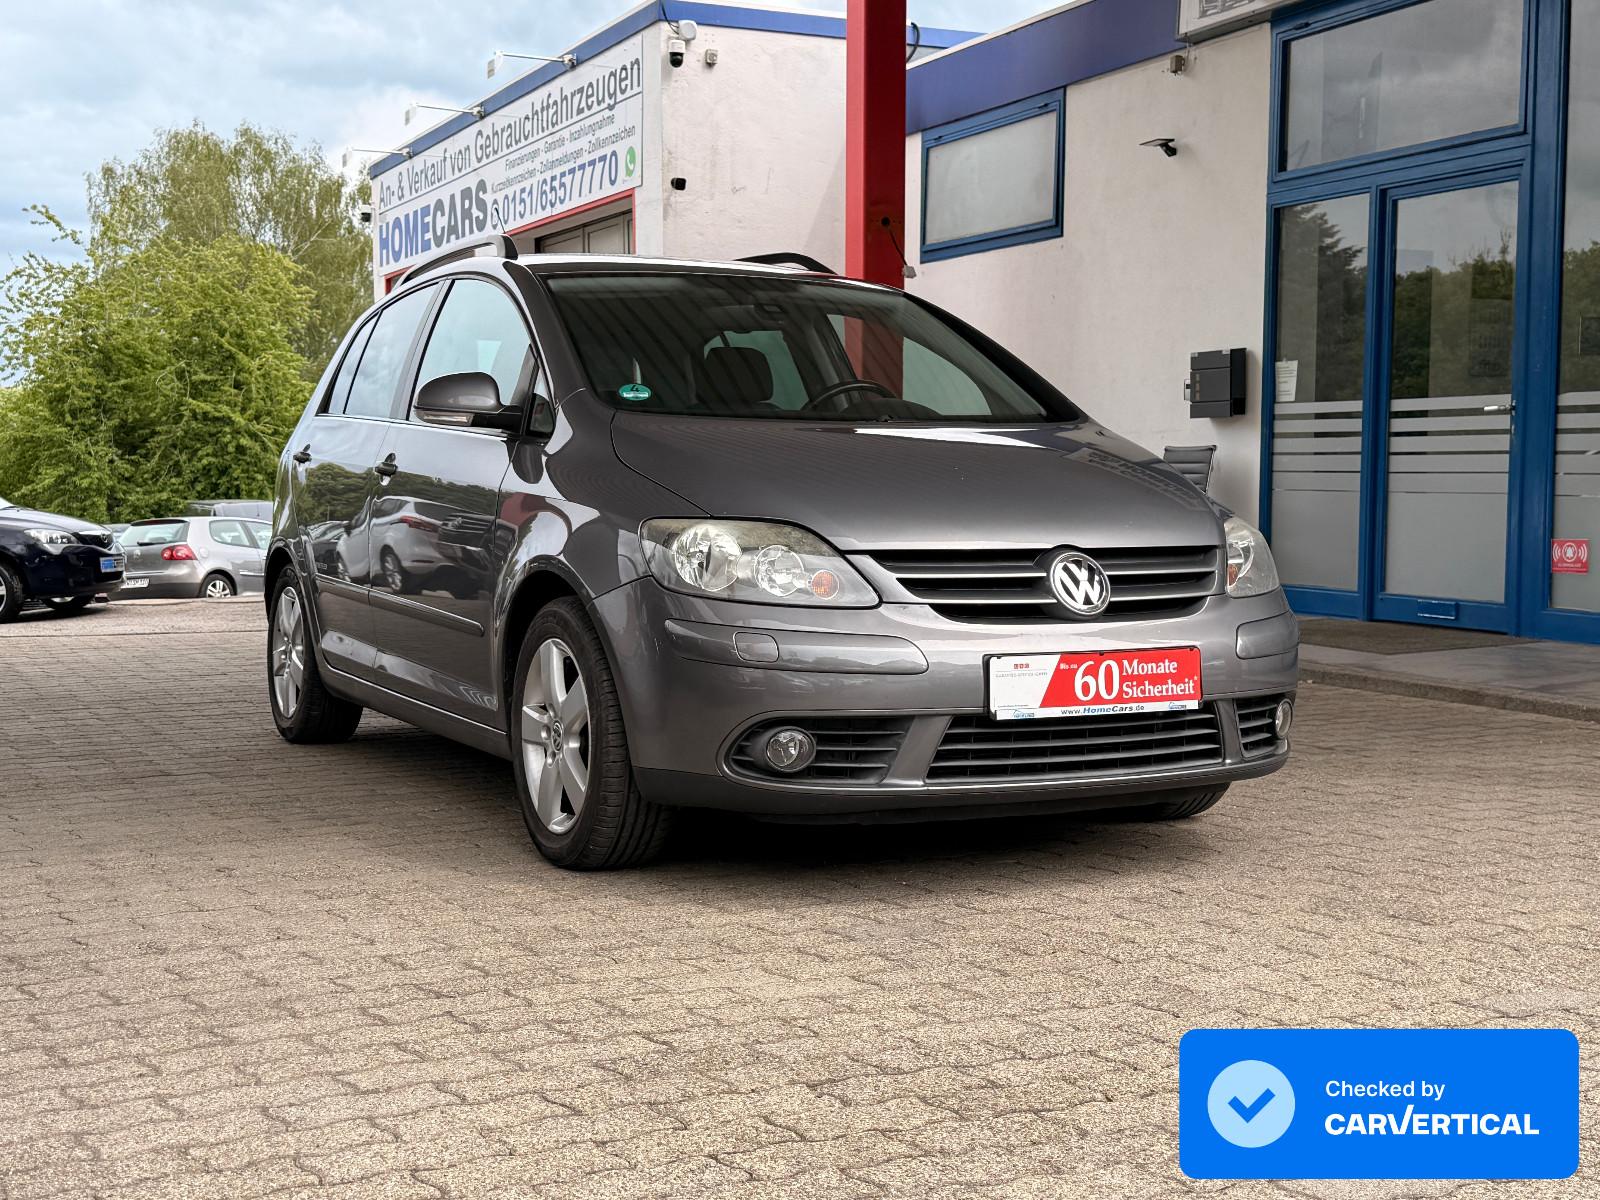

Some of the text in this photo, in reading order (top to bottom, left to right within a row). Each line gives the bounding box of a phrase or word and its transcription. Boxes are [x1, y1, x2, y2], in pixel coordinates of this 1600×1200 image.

[379, 57, 641, 209] An- & Verkauf von Gebrauchtfahrzeugen
[502, 150, 618, 225] 0151/65577770
[378, 178, 488, 267] HOMECARS
[1074, 660, 1120, 701] 60
[1122, 659, 1178, 676] Monate
[1060, 704, 1145, 715] www.HomeCars.de
